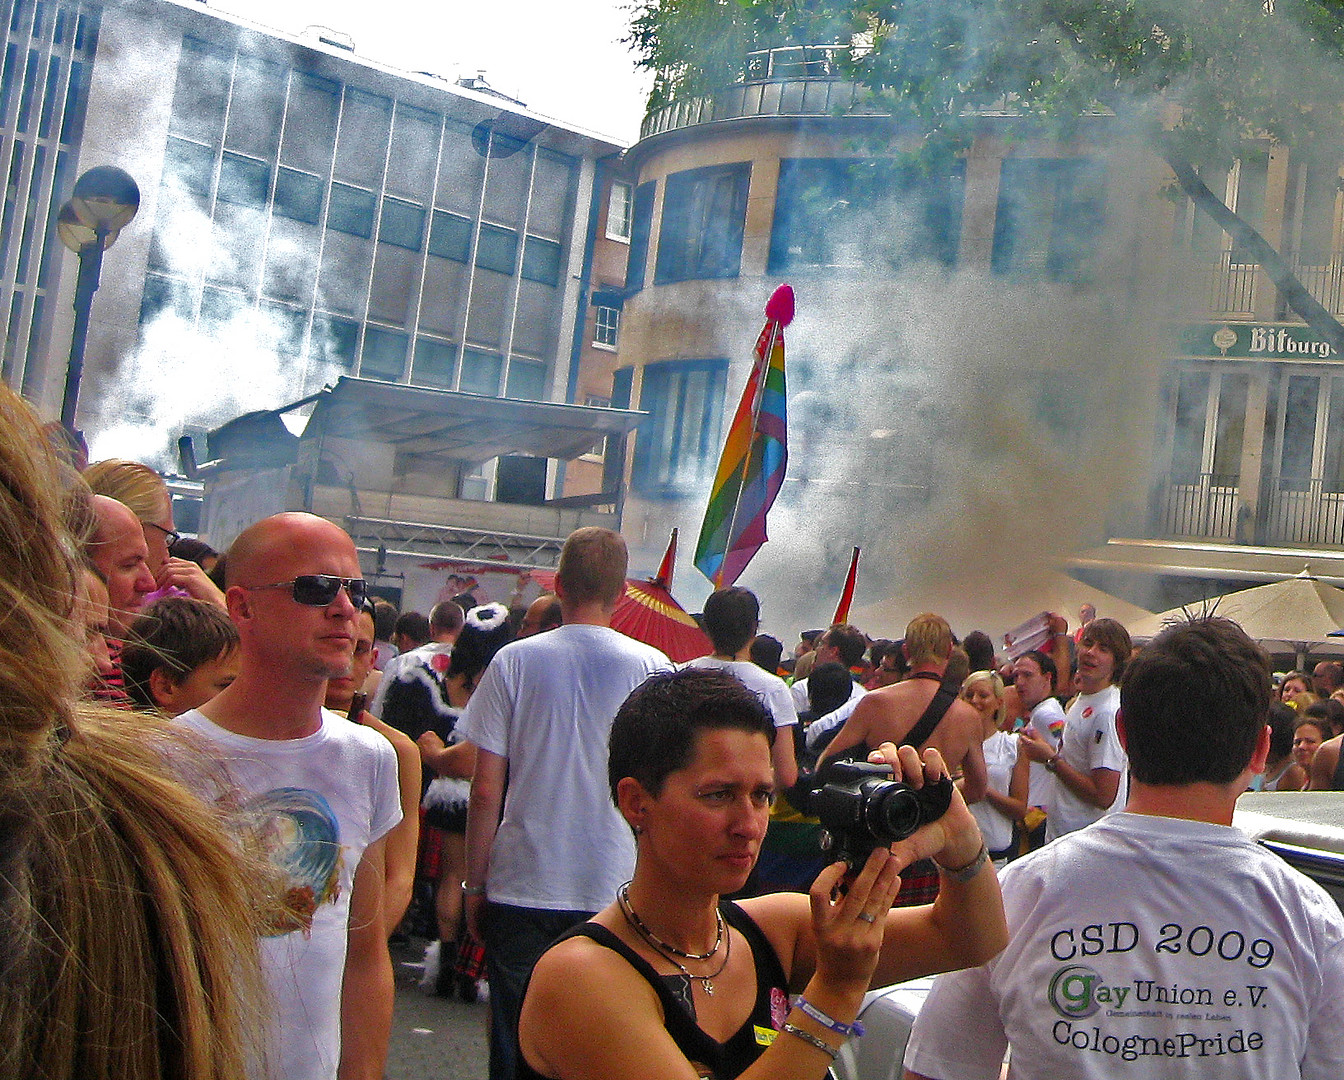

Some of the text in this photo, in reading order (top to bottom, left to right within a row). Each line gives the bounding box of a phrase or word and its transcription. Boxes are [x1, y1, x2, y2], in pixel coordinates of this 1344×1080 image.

[1250, 327, 1337, 358] Bitburg
[1050, 922, 1275, 969] CSD 2009
[1052, 1020, 1264, 1062] ColognePride
